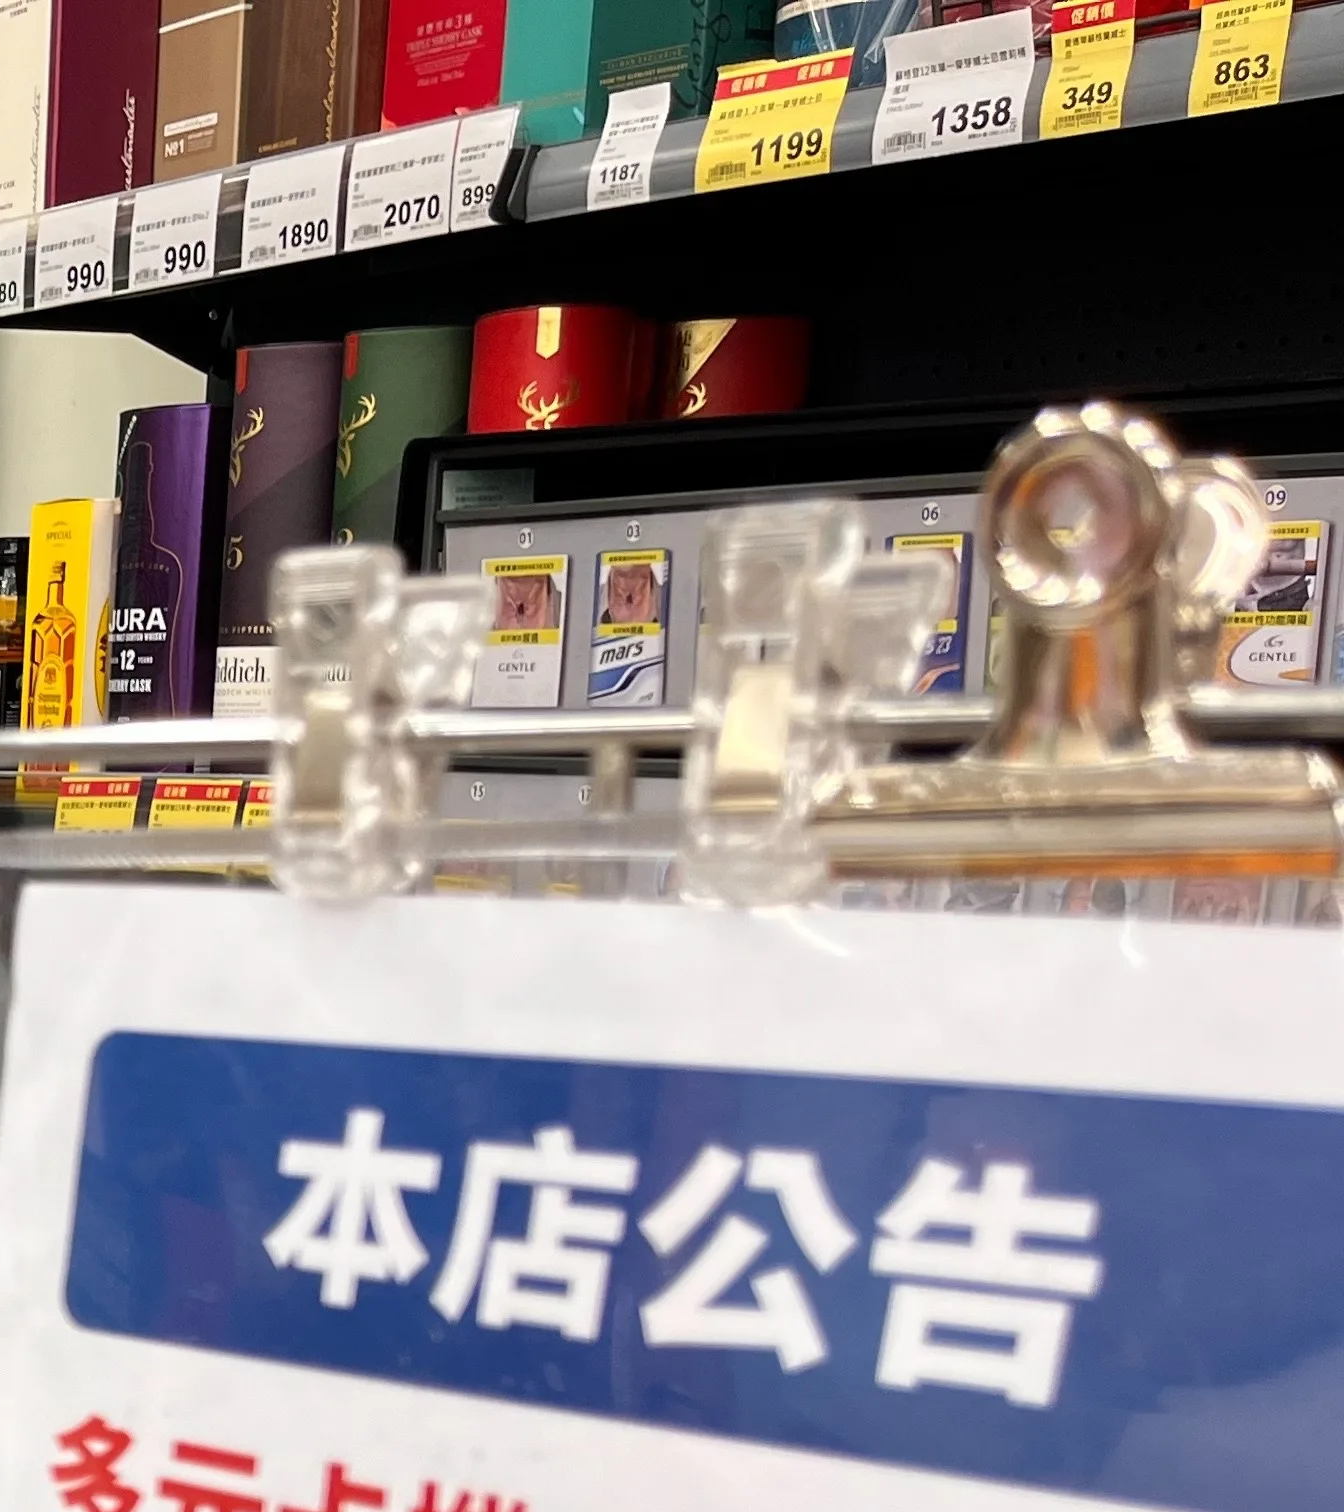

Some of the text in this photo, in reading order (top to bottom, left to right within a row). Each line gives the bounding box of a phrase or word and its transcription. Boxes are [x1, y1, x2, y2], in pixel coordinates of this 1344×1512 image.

[1071, 3, 1115, 25] 促銷價
[731, 61, 835, 94] 促銷價 促銷價
[1214, 53, 1269, 86] 863
[1062, 81, 1112, 110] 349
[932, 96, 1012, 136] 1358
[751, 128, 823, 166] 1199
[600, 163, 640, 184] 1187
[462, 184, 495, 206] 899
[384, 195, 440, 228] 2070
[279, 219, 329, 249] 1890
[164, 241, 206, 274] 990
[67, 261, 105, 292] 990
[1265, 490, 1286, 506] 09
[921, 507, 939, 521] 06
[519, 532, 532, 544] 01
[627, 525, 640, 538] 03
[108, 607, 167, 632] JURA
[120, 649, 136, 671] 12
[600, 641, 644, 665] mars
[1249, 652, 1296, 662] GENTLE
[498, 662, 536, 672] GENTLE
[129, 678, 152, 693] CASK
[473, 785, 484, 798] 15
[261, 1107, 1107, 1411] 本店公告
